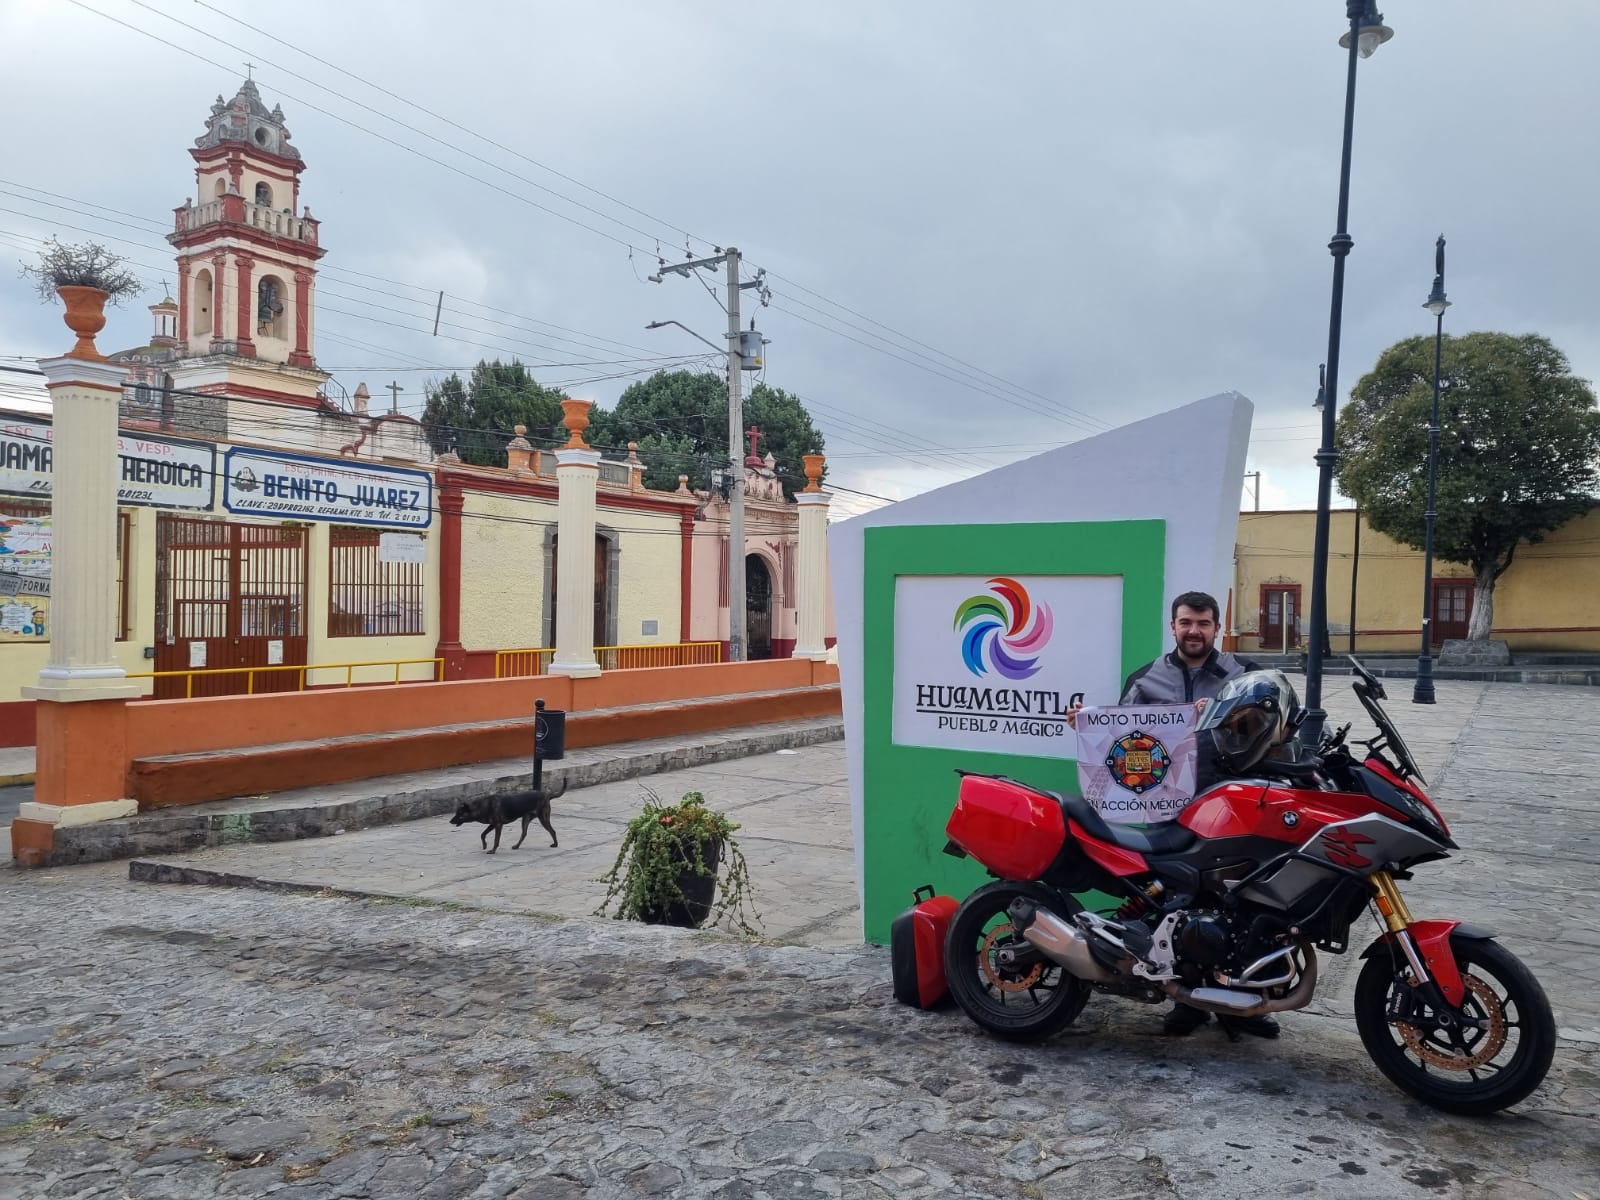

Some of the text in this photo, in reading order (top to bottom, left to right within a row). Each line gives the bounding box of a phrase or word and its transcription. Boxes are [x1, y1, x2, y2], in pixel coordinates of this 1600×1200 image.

[136, 441, 175, 456] VESP.
[122, 457, 203, 489] HEROICA
[263, 473, 420, 512] BENITO JUAREZ
[22, 579, 51, 594] FORMA
[1087, 712, 1185, 726] MOTO TURISTA
[1101, 798, 1147, 811] ACCIÓN
[1150, 797, 1191, 811] MÉXICO
